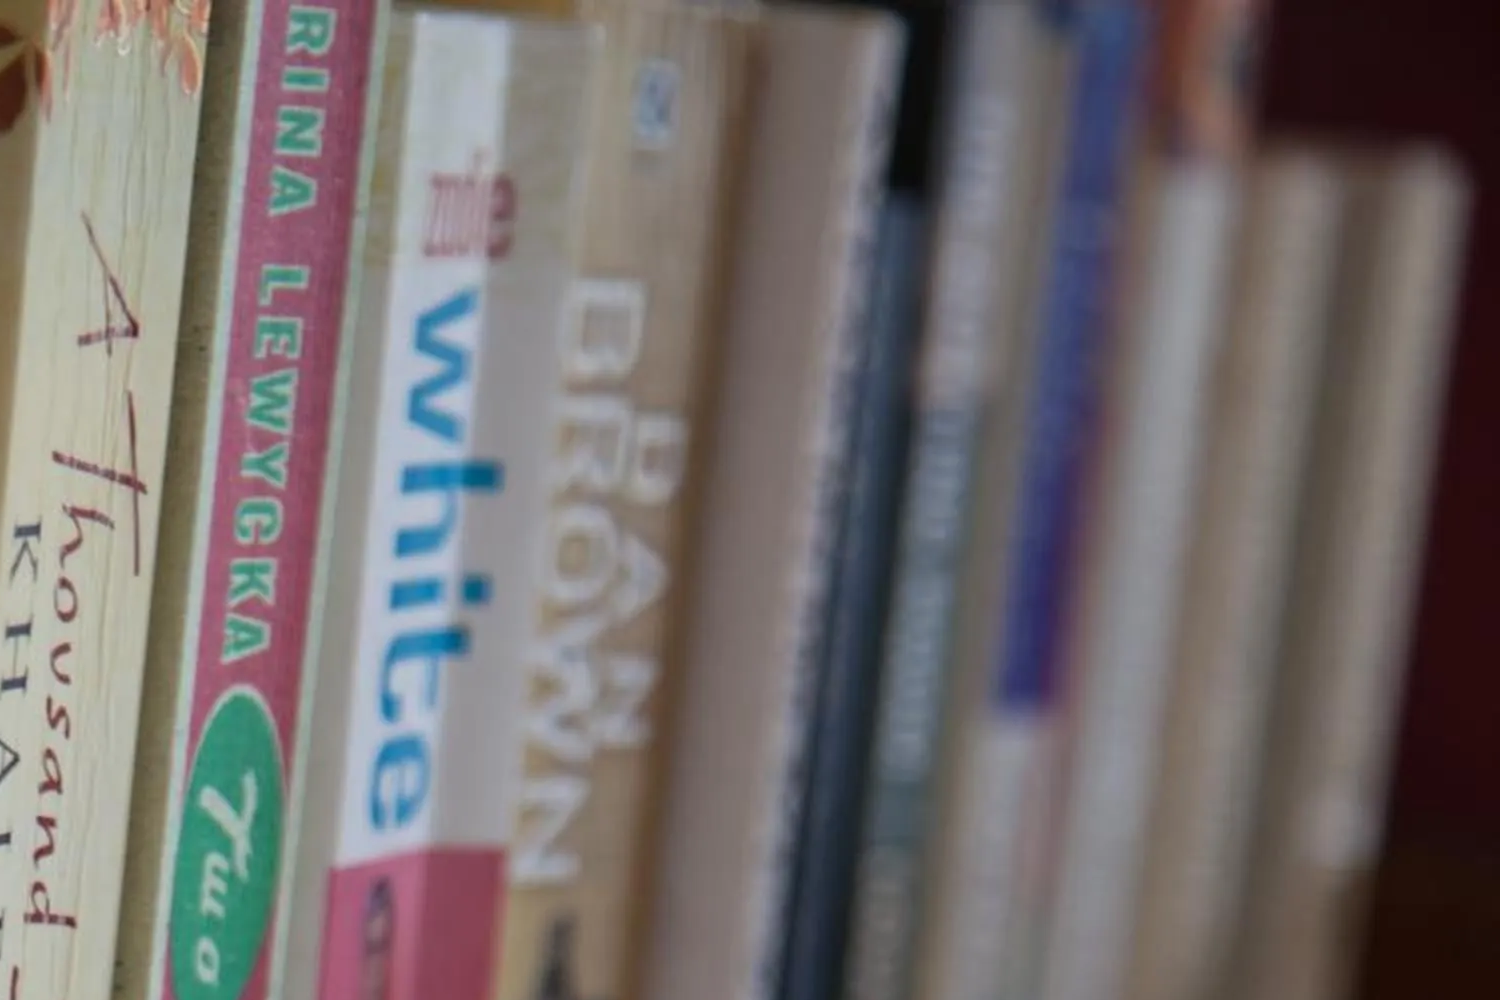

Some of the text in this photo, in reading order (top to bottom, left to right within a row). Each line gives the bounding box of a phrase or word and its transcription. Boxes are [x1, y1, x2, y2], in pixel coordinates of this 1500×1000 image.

[77, 210, 141, 358] A
[220, 4, 338, 665] RINA LEWYCKA
[21, 390, 148, 932] Thousand
[365, 282, 506, 832] white
[195, 765, 259, 990] Two
